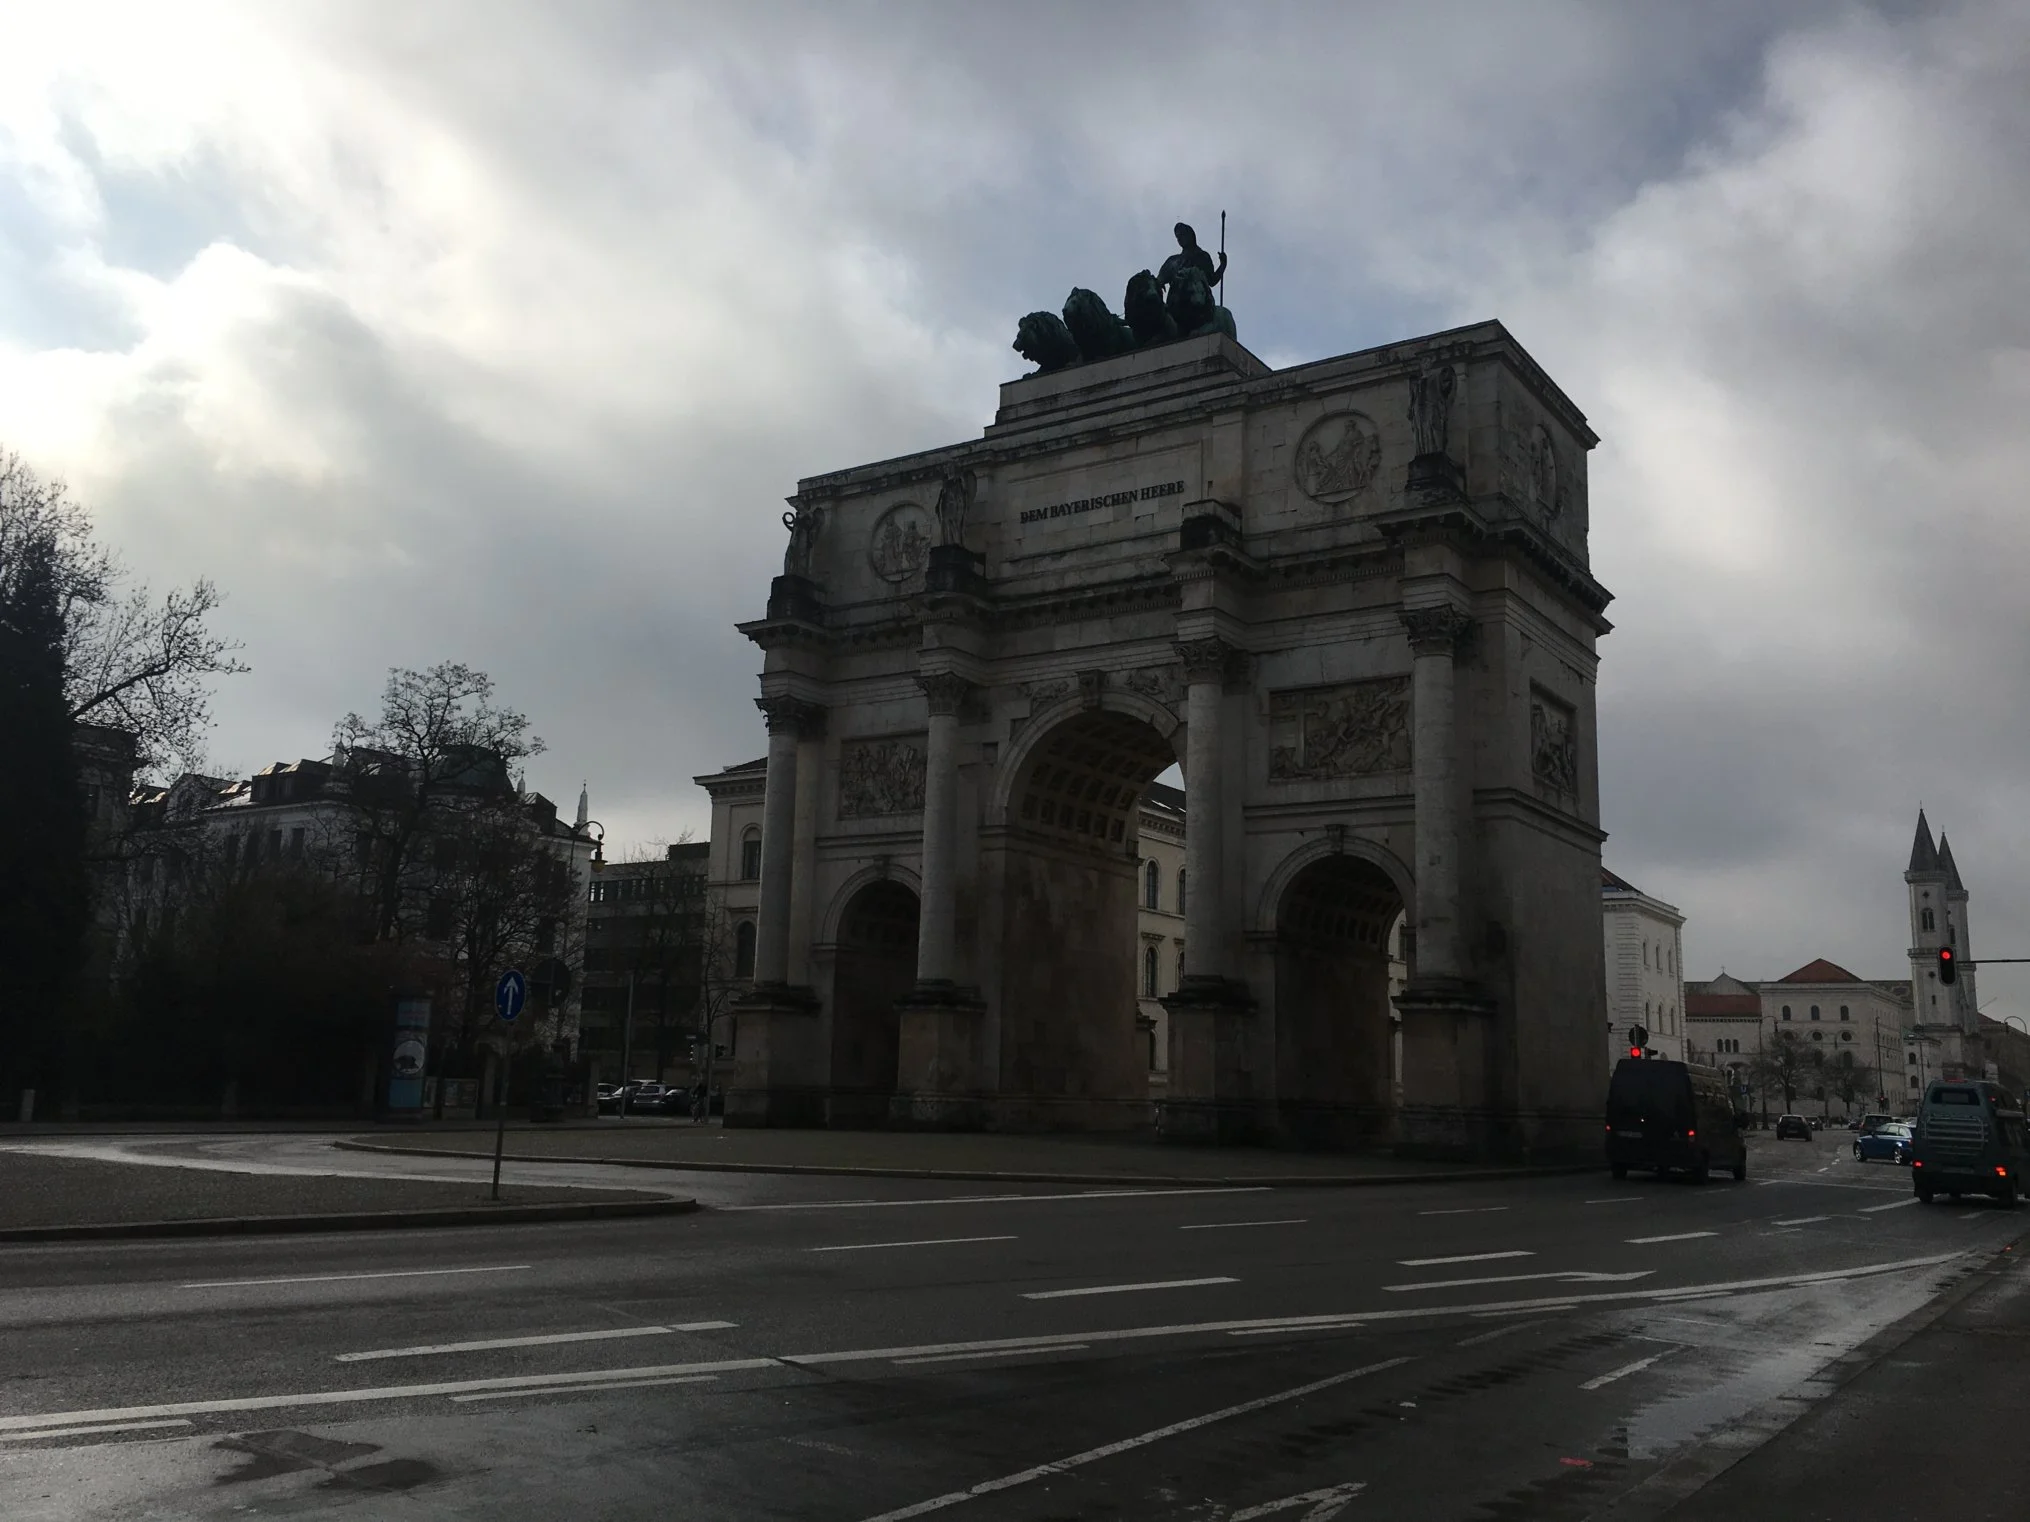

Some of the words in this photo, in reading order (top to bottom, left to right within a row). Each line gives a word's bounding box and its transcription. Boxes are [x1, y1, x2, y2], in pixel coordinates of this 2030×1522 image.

[1020, 507, 1048, 524] DEM
[1050, 490, 1138, 518] BAYERISCHEN
[1140, 480, 1185, 501] HEERE
